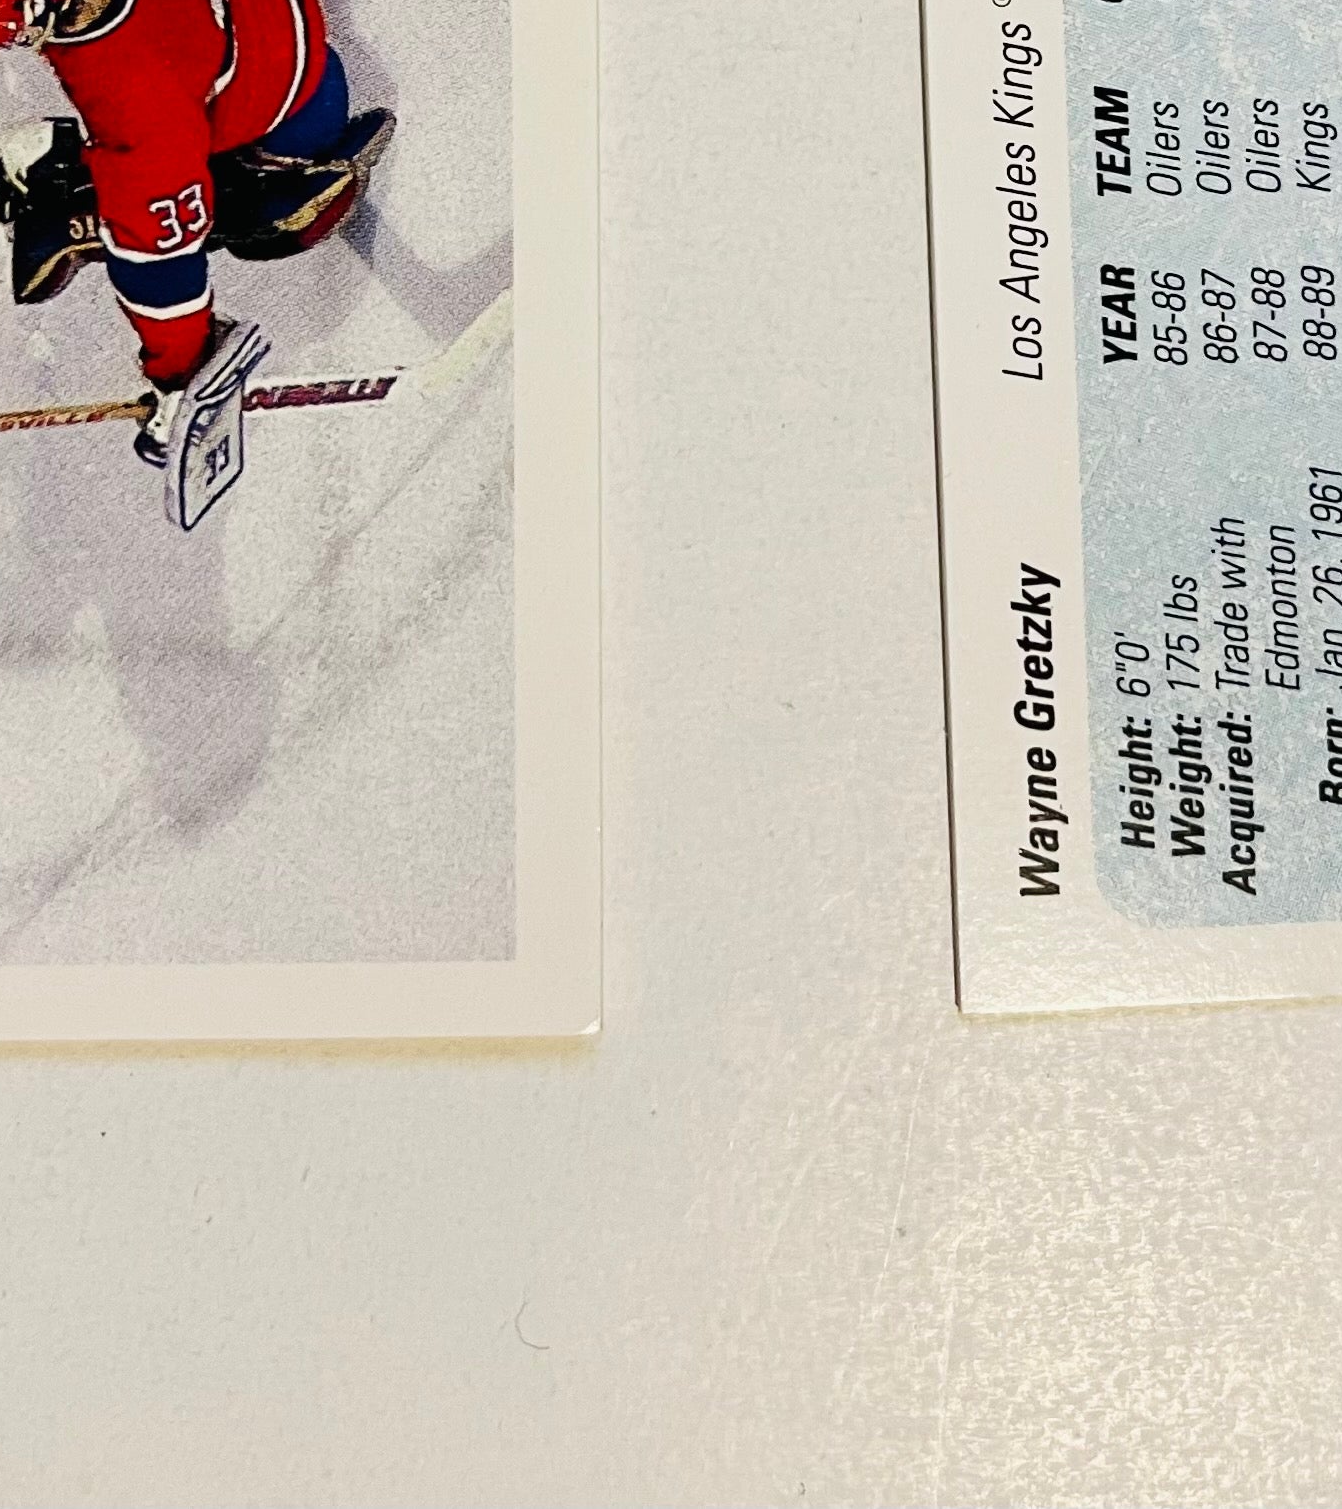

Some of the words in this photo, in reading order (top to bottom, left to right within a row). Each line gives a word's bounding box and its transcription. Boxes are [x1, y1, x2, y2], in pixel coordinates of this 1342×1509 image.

[993, 22, 1042, 127] Kings
[1094, 86, 1131, 196] TEAM
[1146, 102, 1182, 196] Oilers
[1246, 99, 1281, 192] Oilers
[149, 183, 209, 249] 33
[996, 143, 1048, 303] Angeles
[1002, 315, 1042, 380] Los
[1100, 264, 1137, 364] YEAR
[1151, 271, 1187, 365] 85-86
[1251, 267, 1287, 362] 87-88
[1163, 575, 1198, 622] lbs
[1210, 518, 1246, 588] with
[1011, 563, 1060, 730] Gretzky
[1214, 603, 1250, 689] Trade
[1264, 526, 1300, 690] Edmonton
[1165, 633, 1199, 689] 175
[1019, 747, 1068, 896] Wayne
[1118, 716, 1161, 848] Height:
[1169, 714, 1212, 856] Weight:
[1217, 712, 1264, 895] Acquired:
